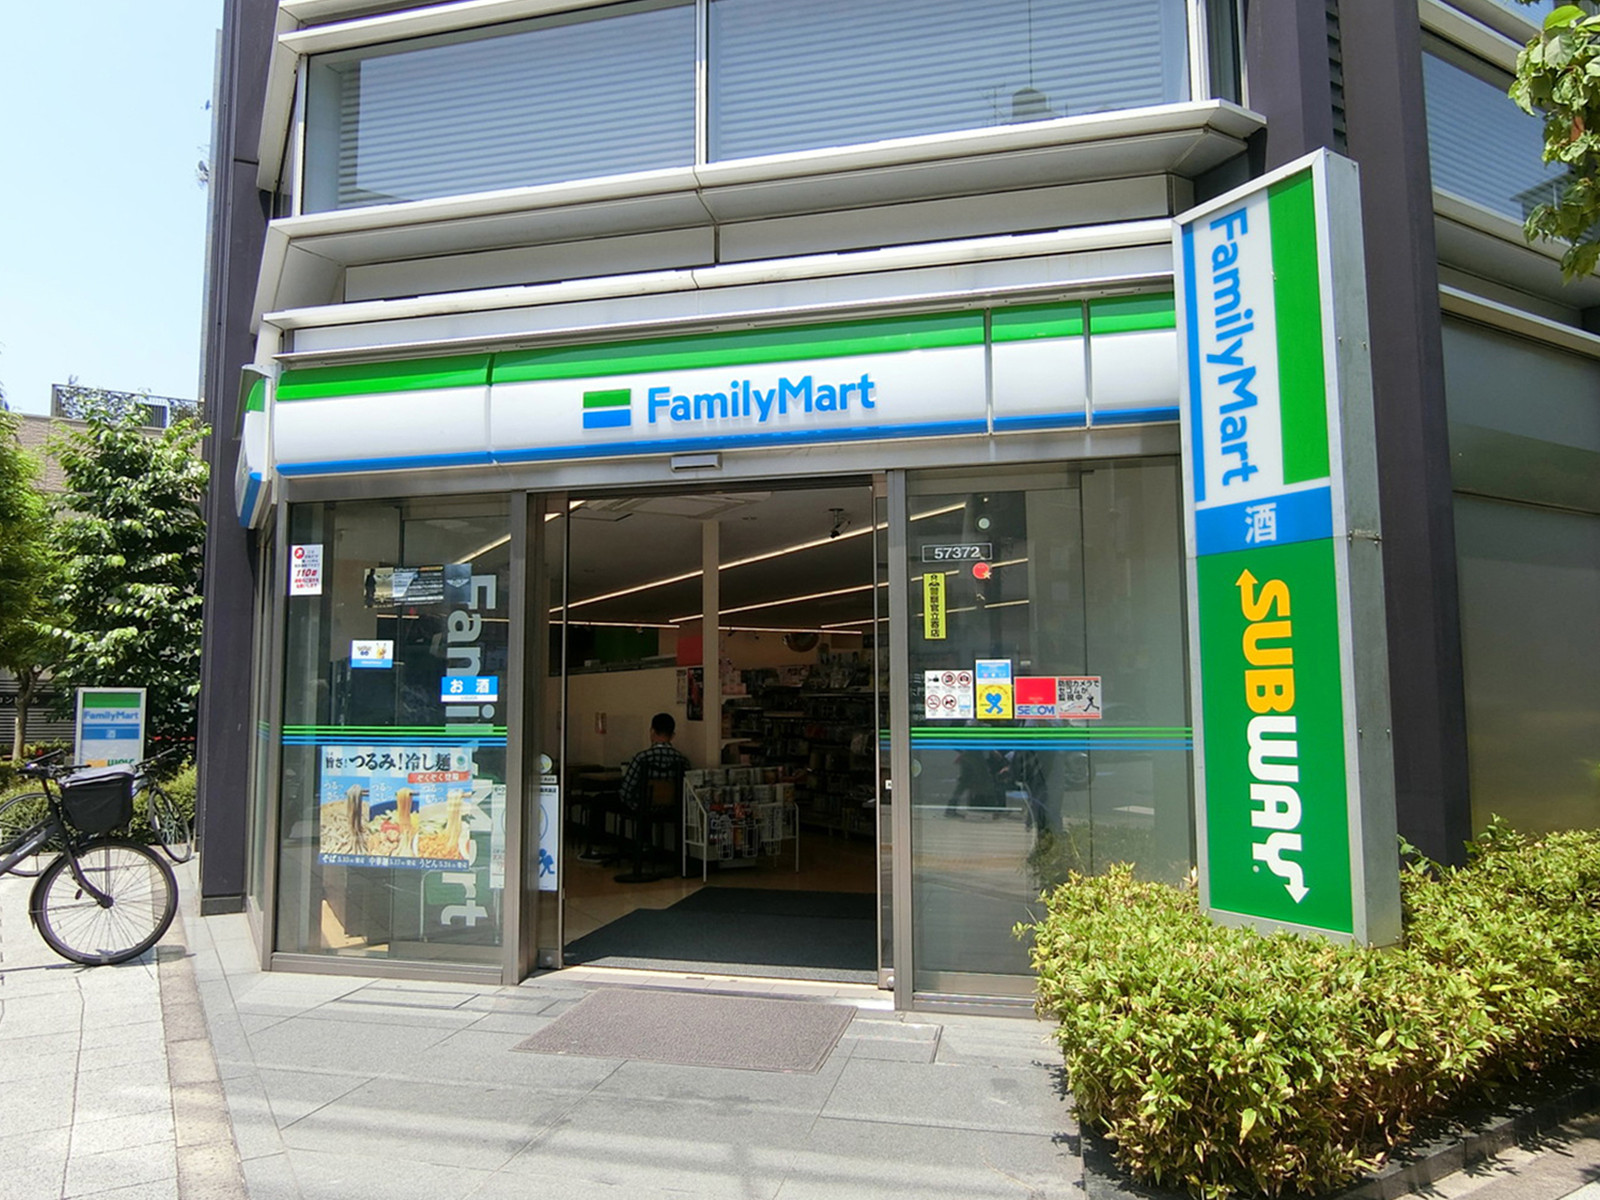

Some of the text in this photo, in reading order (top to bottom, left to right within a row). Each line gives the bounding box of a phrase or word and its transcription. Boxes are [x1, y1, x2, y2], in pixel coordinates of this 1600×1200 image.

[1206, 206, 1259, 488] FamilyMart
[648, 373, 876, 423] FamilyMart
[1243, 501, 1278, 544] 酒
[934, 546, 980, 559] 57372
[450, 678, 490, 694] お酒
[1058, 680, 1100, 688] 防犯カメラで
[83, 711, 139, 721] FamilyMart
[1017, 705, 1055, 715] SECOM
[1235, 568, 1310, 904] SUBWAY
